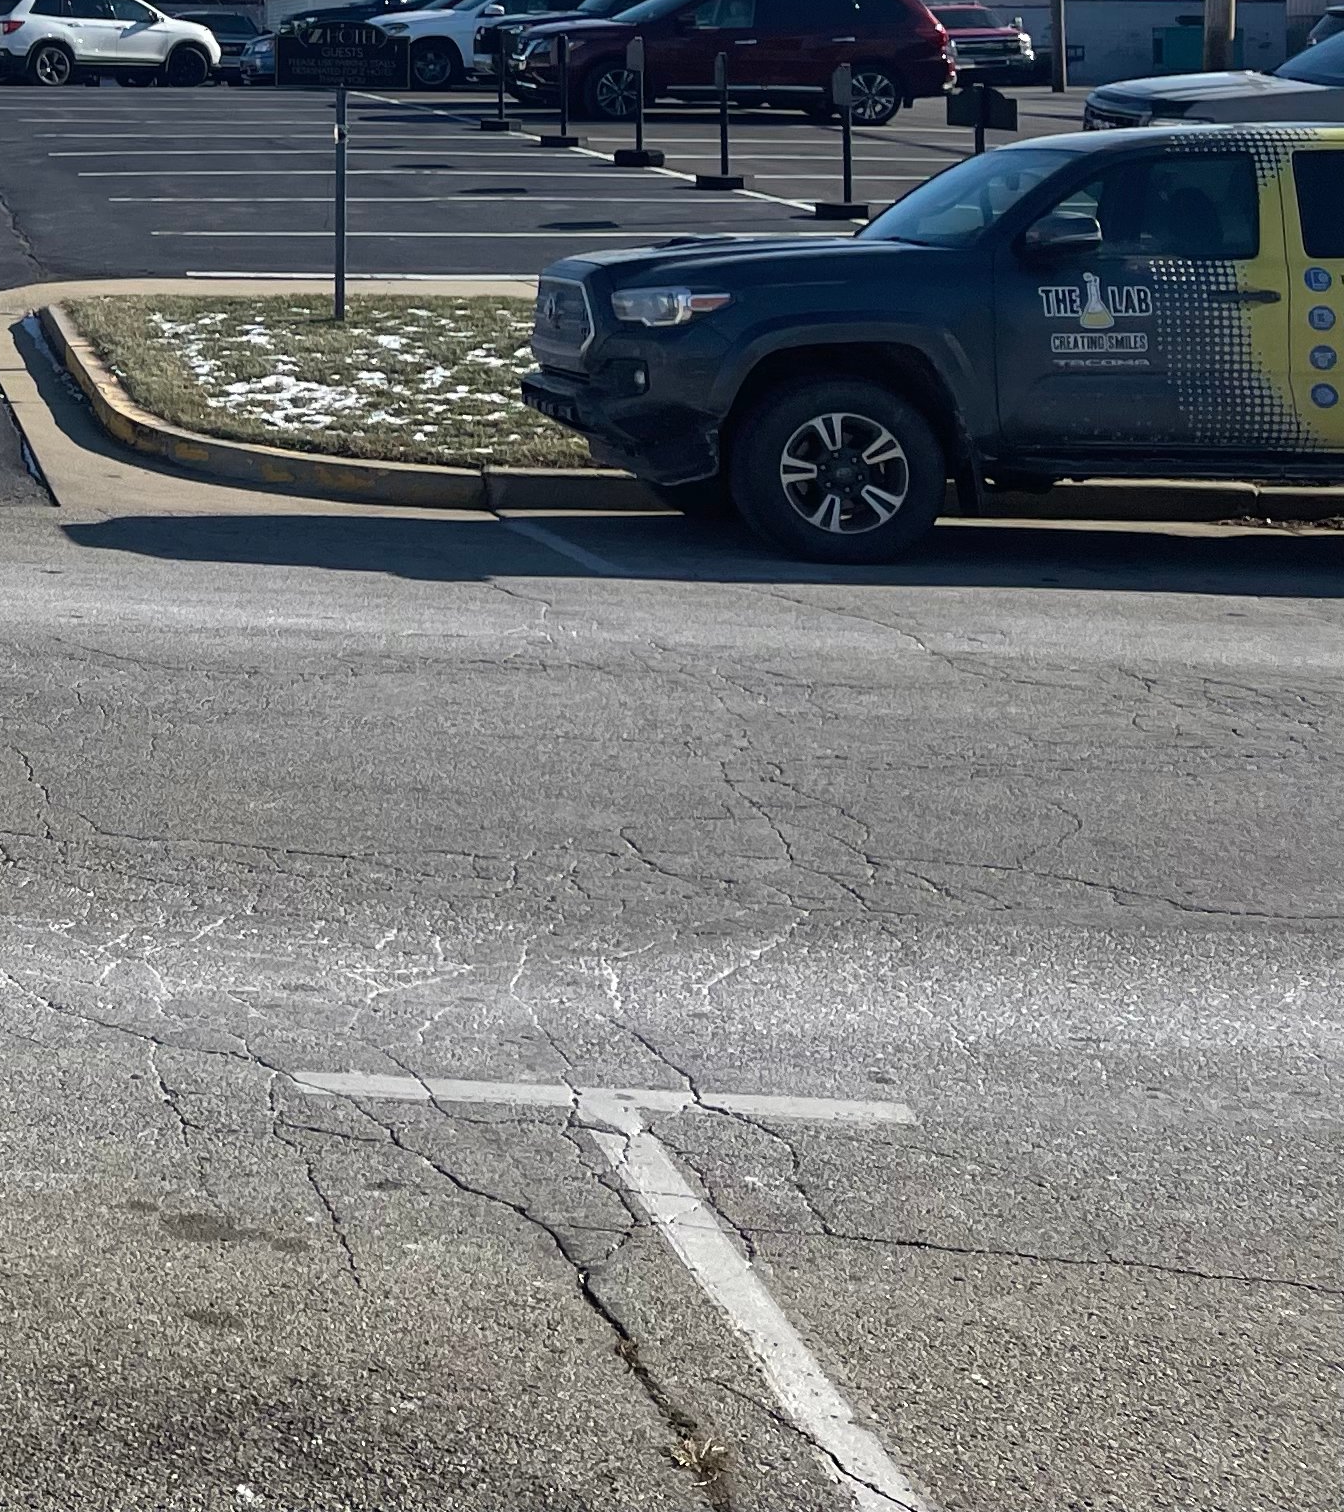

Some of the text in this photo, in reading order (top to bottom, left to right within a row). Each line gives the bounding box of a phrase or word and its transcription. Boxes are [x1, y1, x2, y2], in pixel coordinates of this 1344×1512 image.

[320, 46, 364, 58] GUESTS
[1039, 286, 1152, 317] THE LAB
[1052, 334, 1147, 351] CREATING SMILES
